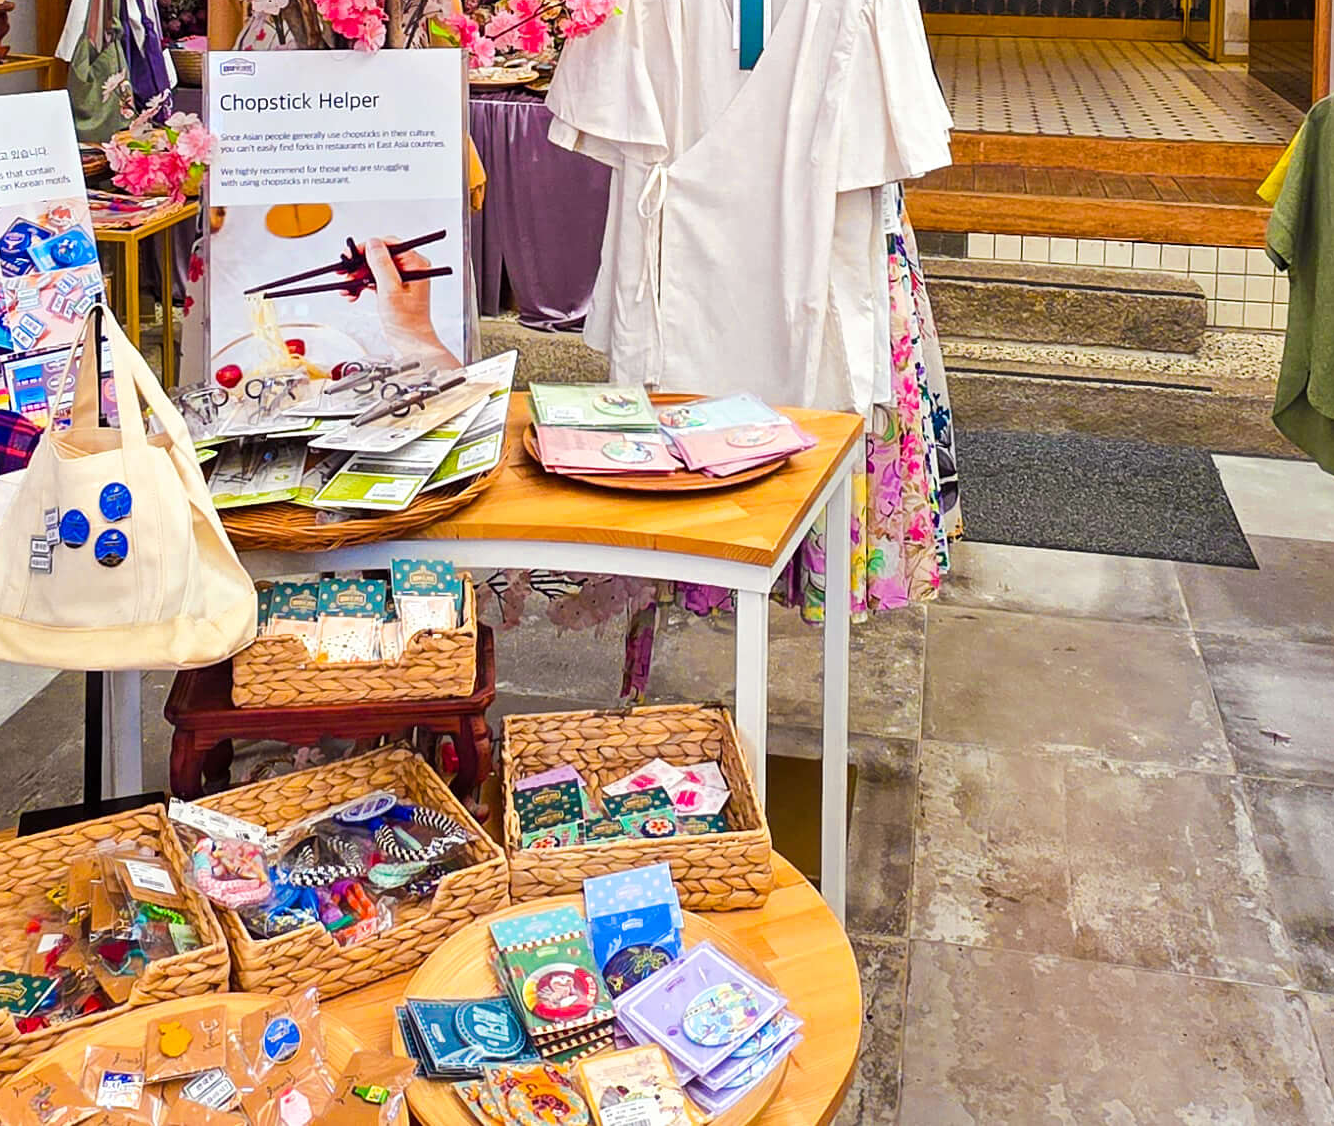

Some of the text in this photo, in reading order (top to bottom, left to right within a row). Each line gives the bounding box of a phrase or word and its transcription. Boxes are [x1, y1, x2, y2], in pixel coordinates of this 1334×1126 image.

[220, 92, 380, 112] Chopstick Helper
[6, 170, 23, 178] that
[25, 166, 55, 176] contain
[1, 183, 12, 191] on
[14, 178, 43, 188] Korean
